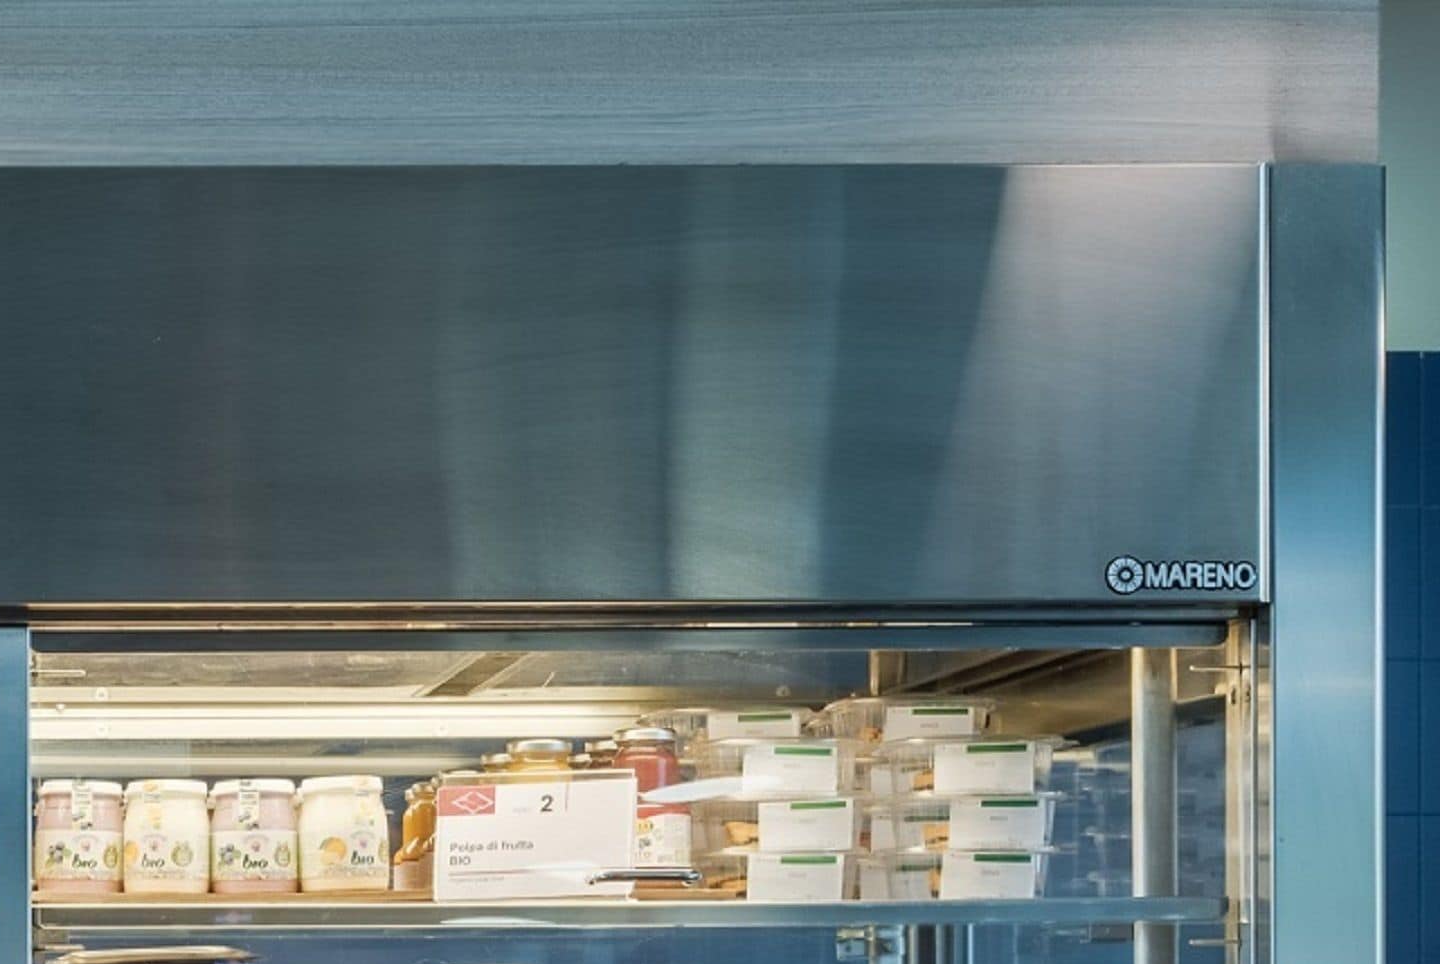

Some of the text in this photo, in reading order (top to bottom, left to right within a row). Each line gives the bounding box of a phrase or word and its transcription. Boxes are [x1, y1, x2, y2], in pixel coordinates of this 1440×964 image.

[1144, 562, 1257, 589] MARENO
[540, 795, 553, 812] 2
[450, 840, 534, 854] Polpa di frutta
[72, 853, 98, 868] bio
[141, 853, 165, 867] bio
[242, 854, 269, 868] bio
[449, 856, 471, 866] BIO
